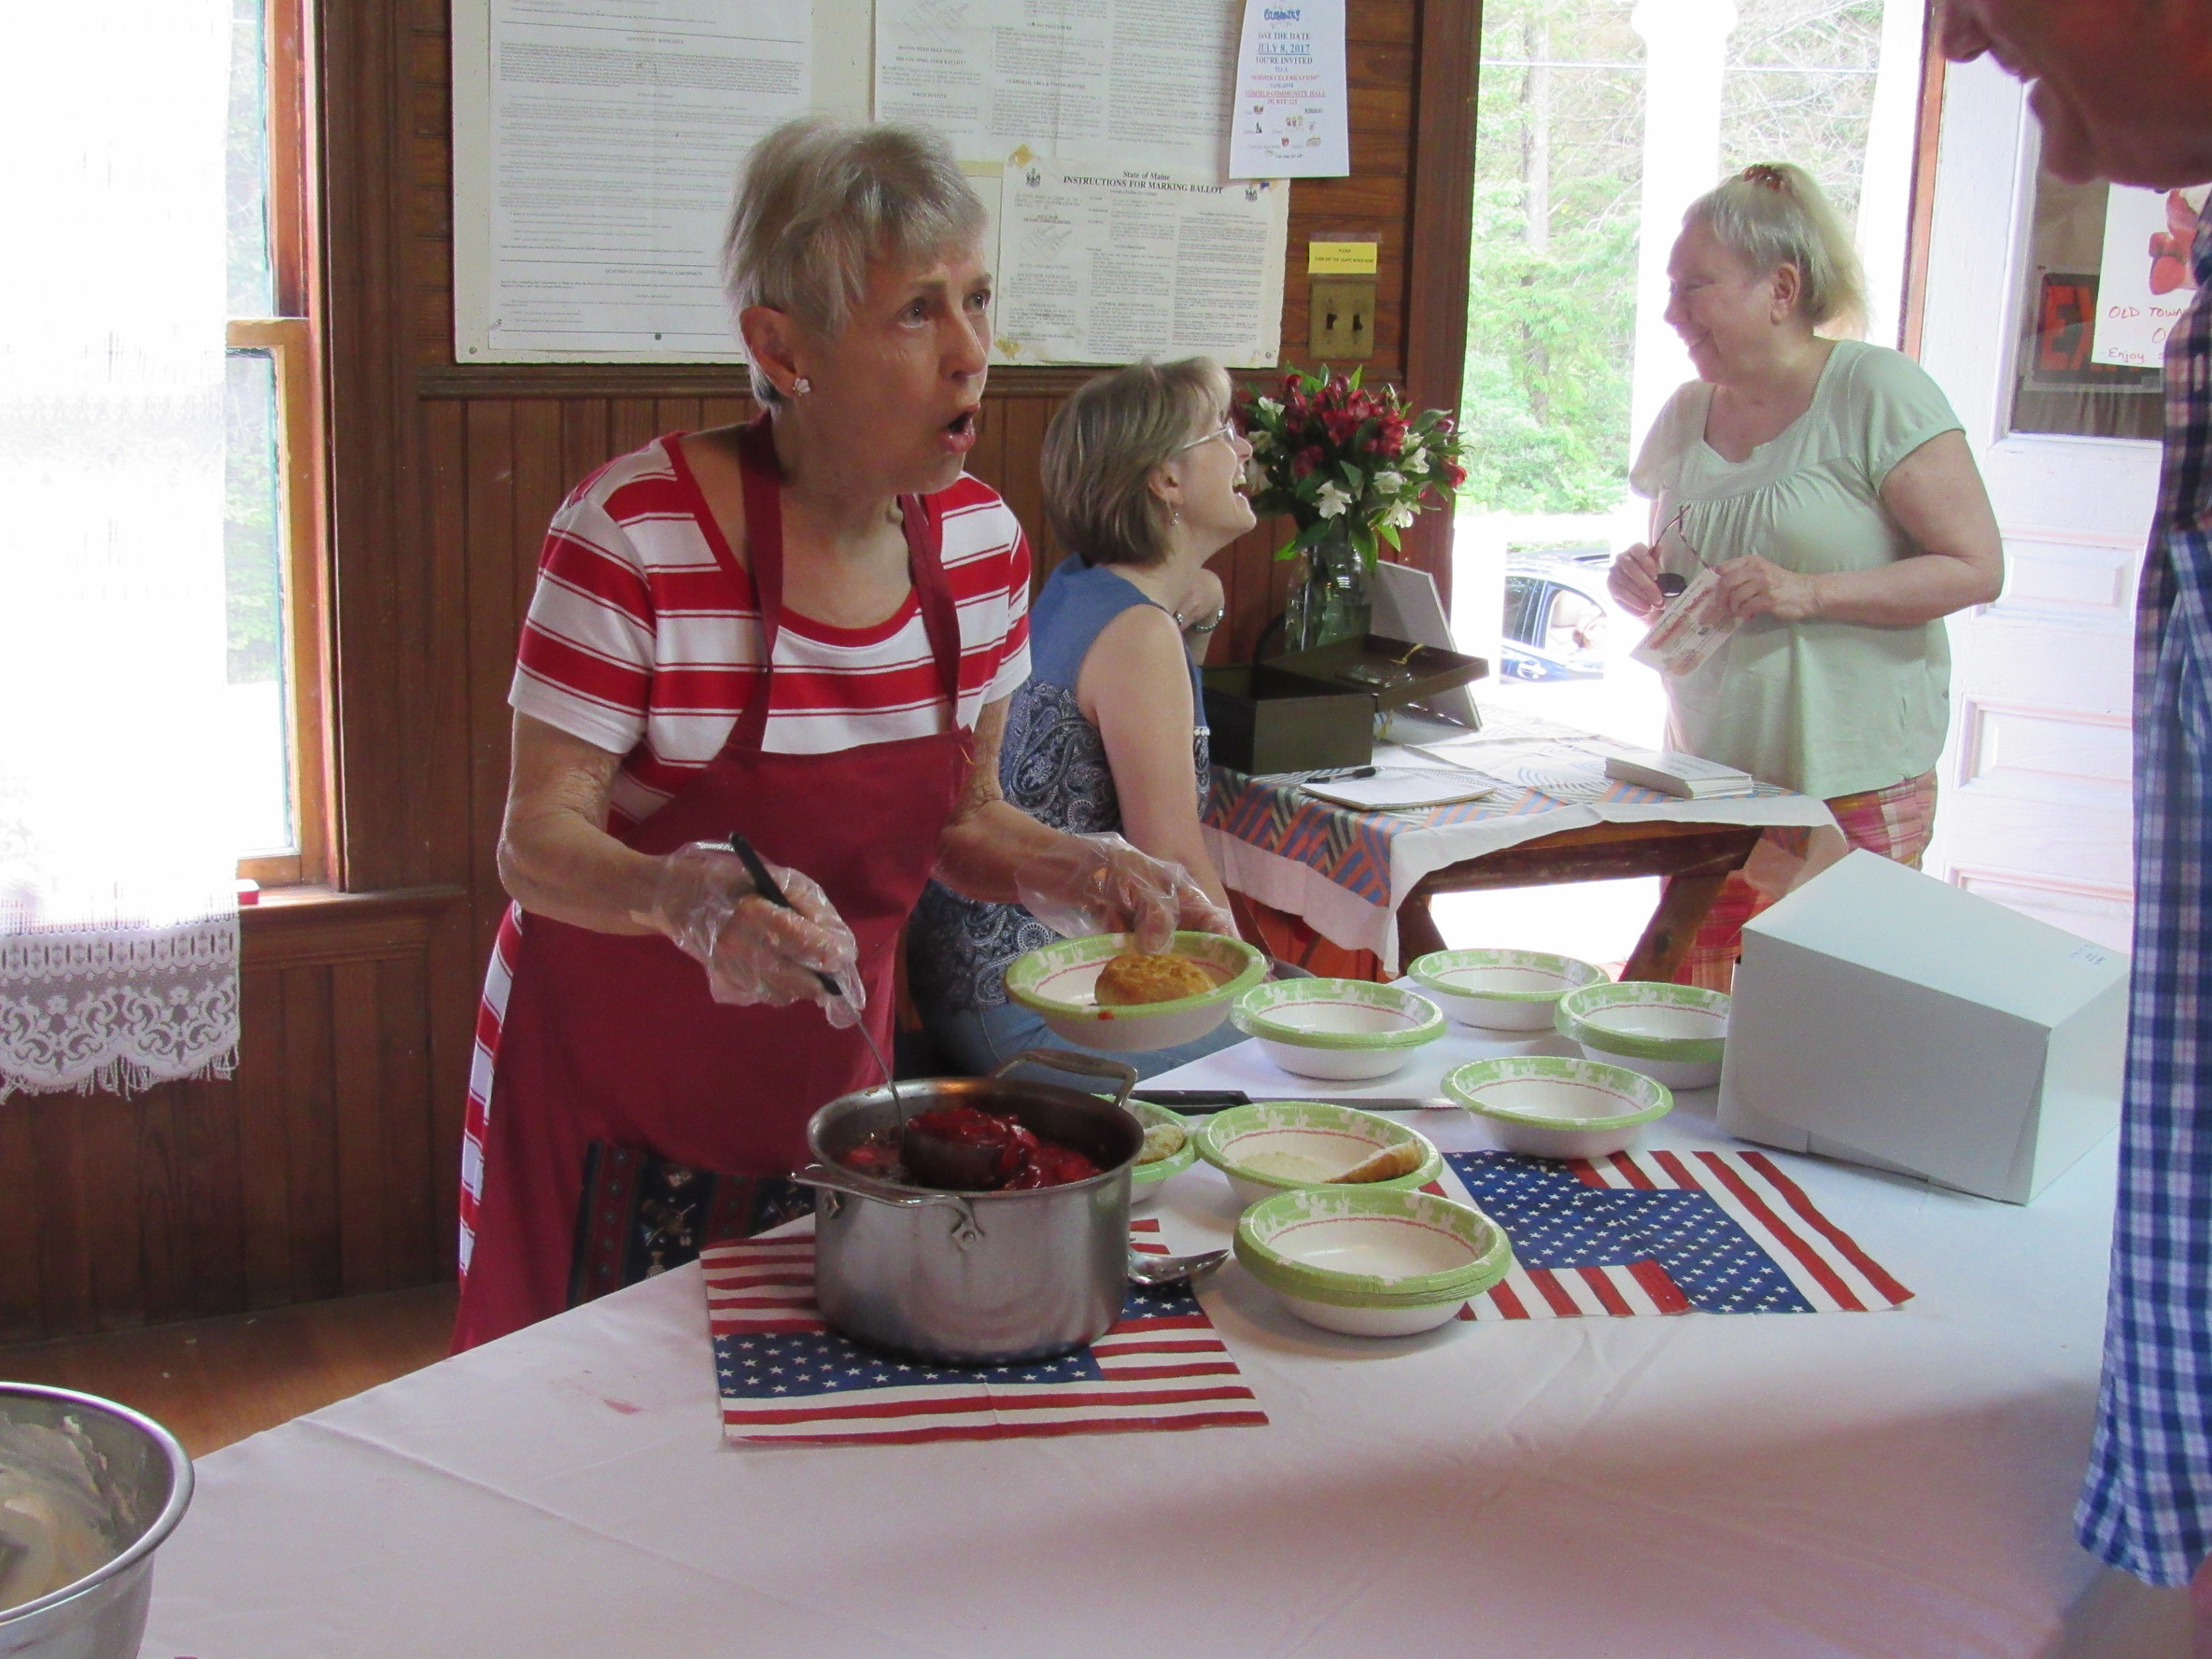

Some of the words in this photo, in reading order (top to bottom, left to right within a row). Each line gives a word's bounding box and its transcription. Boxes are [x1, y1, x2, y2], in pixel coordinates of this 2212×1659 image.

[1258, 43, 1277, 53] JULY
[1280, 43, 1289, 54] 8,
[1290, 43, 1311, 53] 2017
[1150, 173, 1171, 181] Maine
[1064, 176, 1127, 188] INSTRUCTIONS
[1129, 180, 1146, 189] FOR
[1148, 181, 1188, 191] MARKING
[1190, 184, 1224, 194] BALLOT
[2107, 305, 2140, 319] OLD
[2107, 347, 2145, 365] Enjoy
